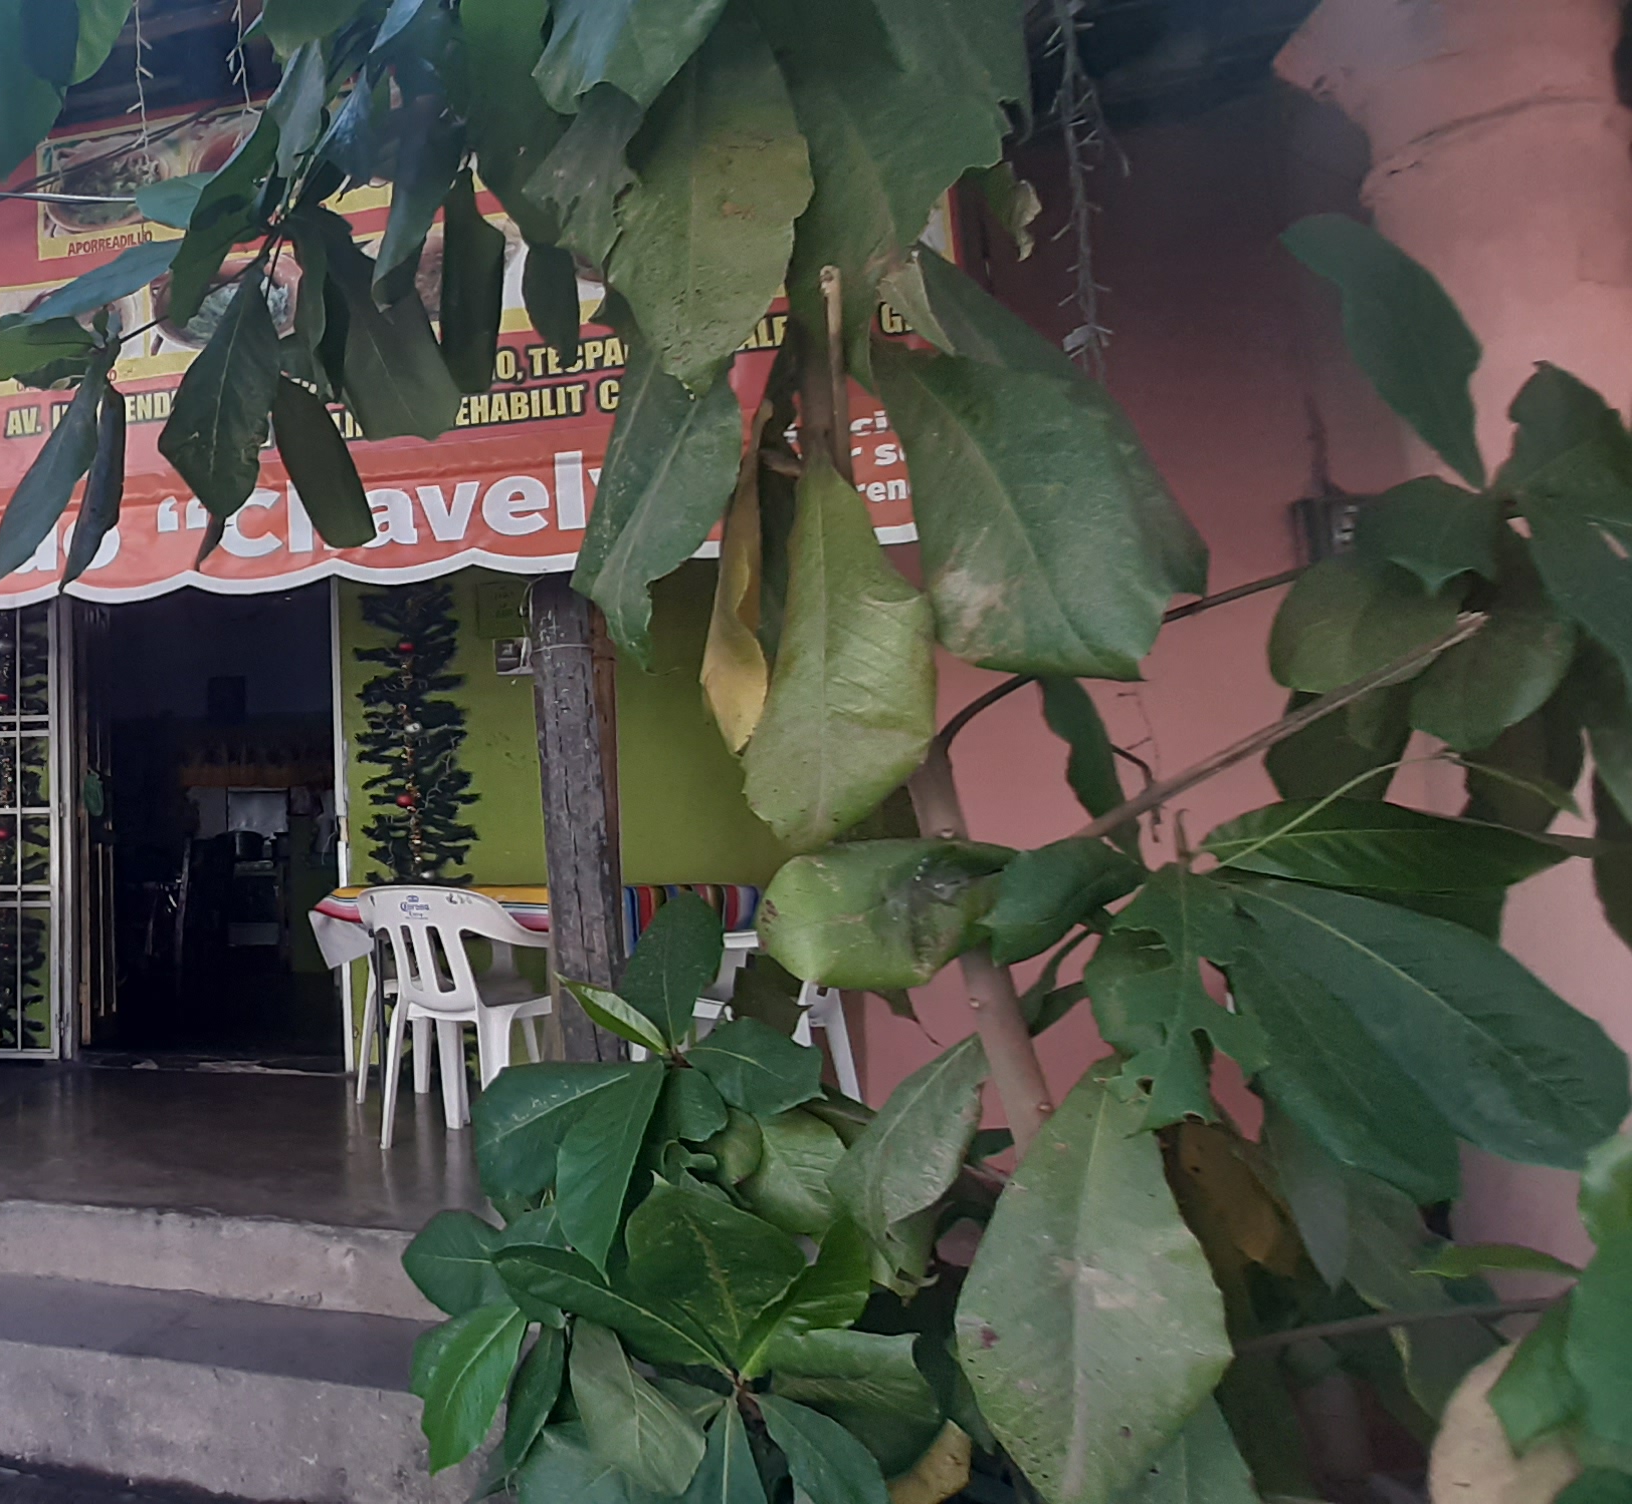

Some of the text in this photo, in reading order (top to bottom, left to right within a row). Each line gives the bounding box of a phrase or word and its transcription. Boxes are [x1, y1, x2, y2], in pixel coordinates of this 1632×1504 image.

[67, 230, 153, 256] APORREADILLO
[527, 336, 629, 377] TECPA
[7, 407, 42, 437] AV.
[455, 383, 585, 426] EHABILIT
